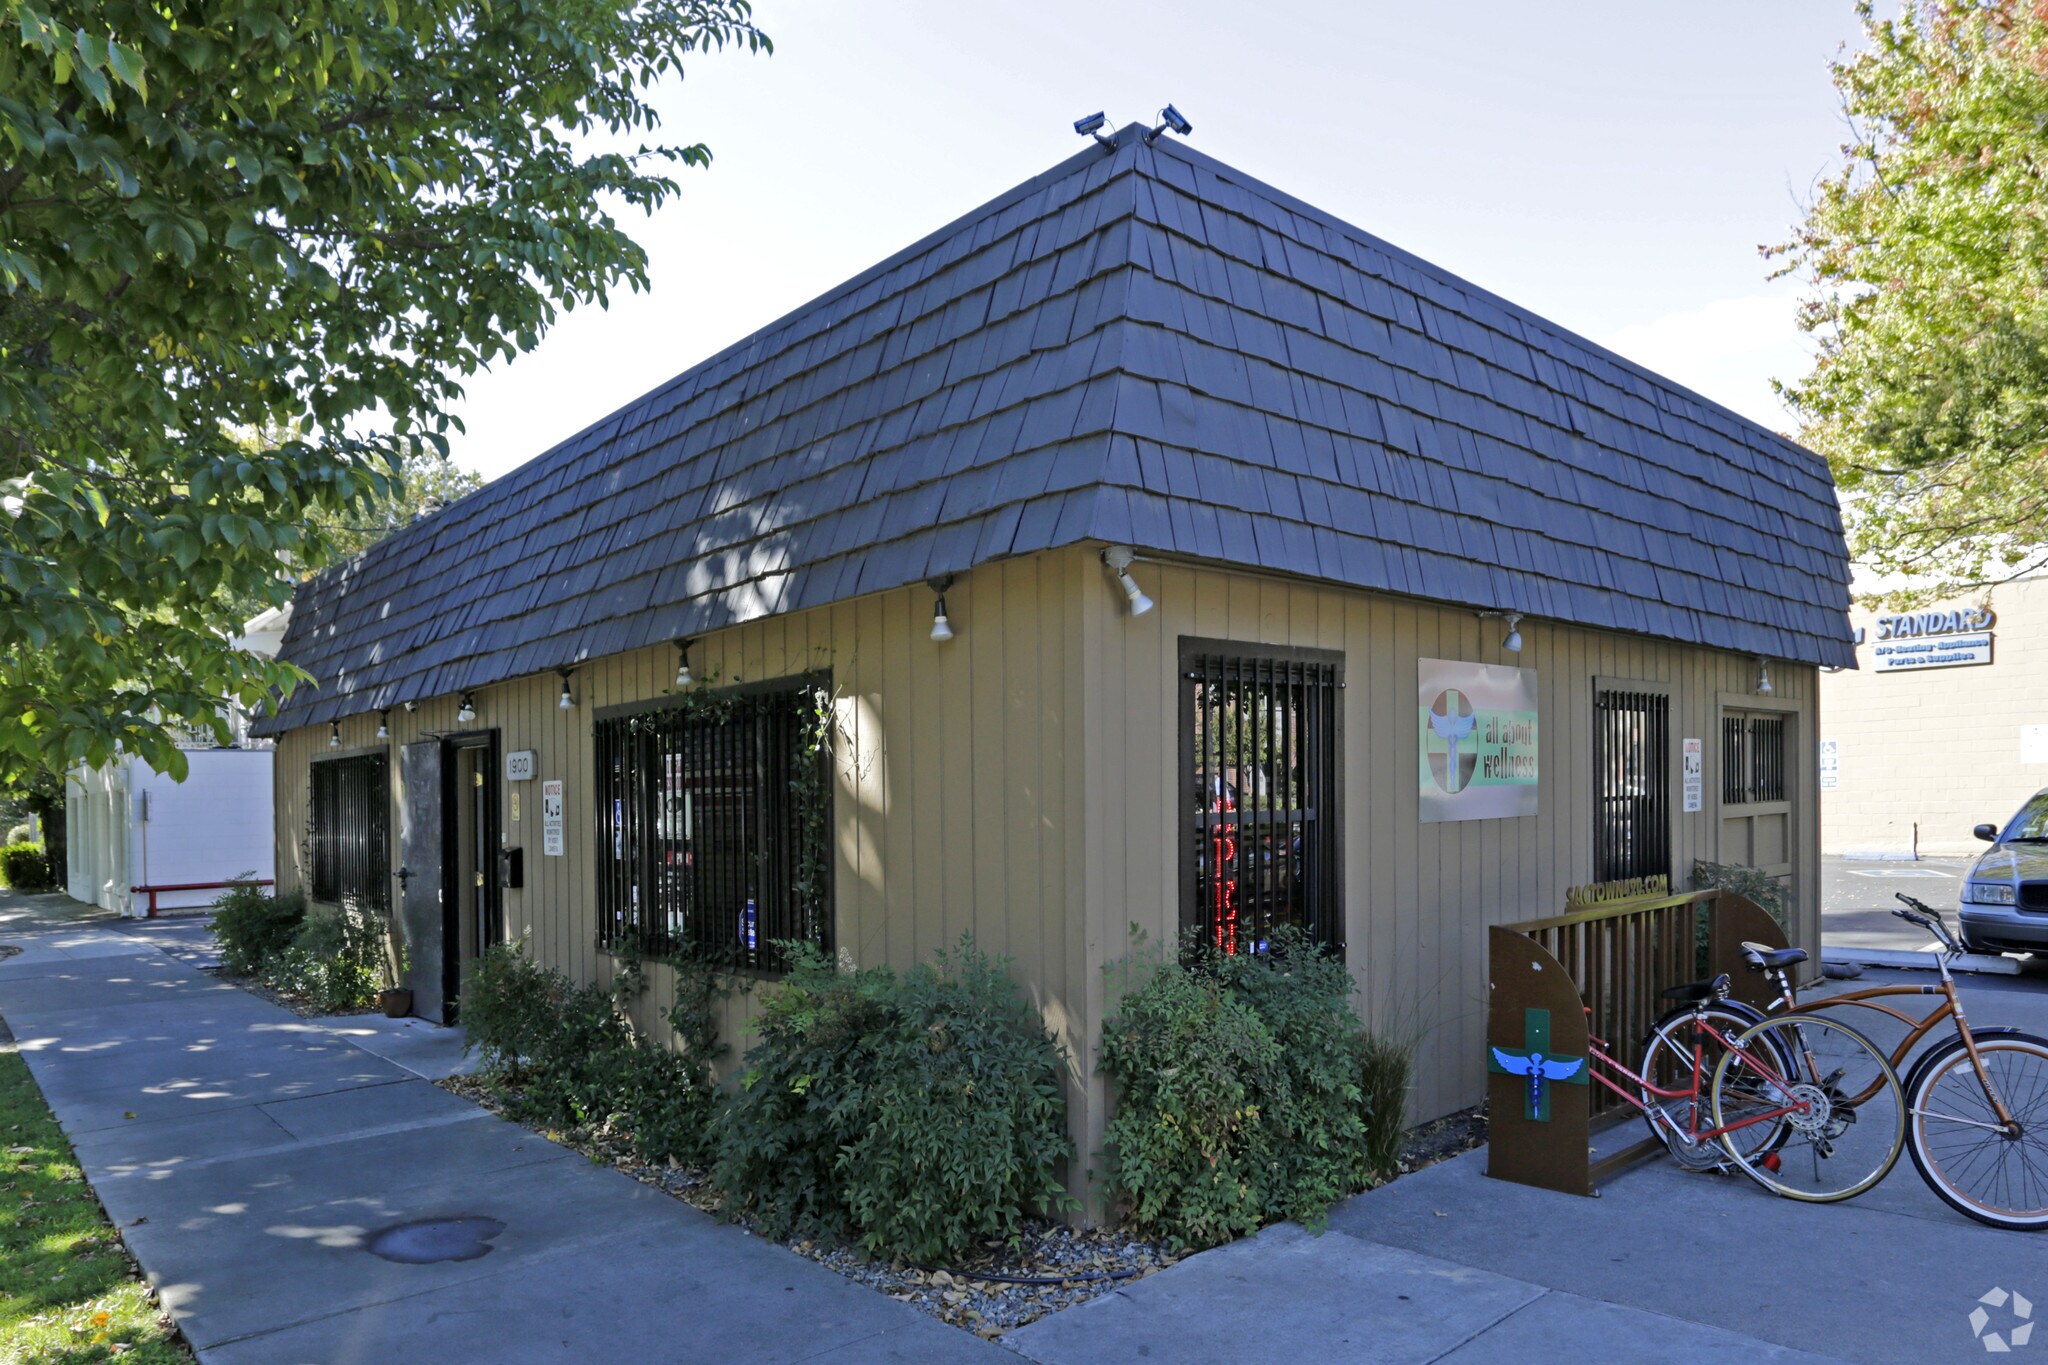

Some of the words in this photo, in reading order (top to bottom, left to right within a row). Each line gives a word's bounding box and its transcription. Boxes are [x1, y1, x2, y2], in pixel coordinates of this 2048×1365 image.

[1874, 607, 1993, 639] STANDARD
[1937, 638, 1989, 651] Appliance
[1926, 652, 1975, 664] Supplies
[1485, 716, 1499, 744] all
[1502, 719, 1532, 746] about
[509, 757, 529, 774] 1900
[1483, 746, 1535, 779] wellness
[544, 784, 561, 796] NOTICE
[1566, 873, 1668, 905] SACTOWN420.COM
